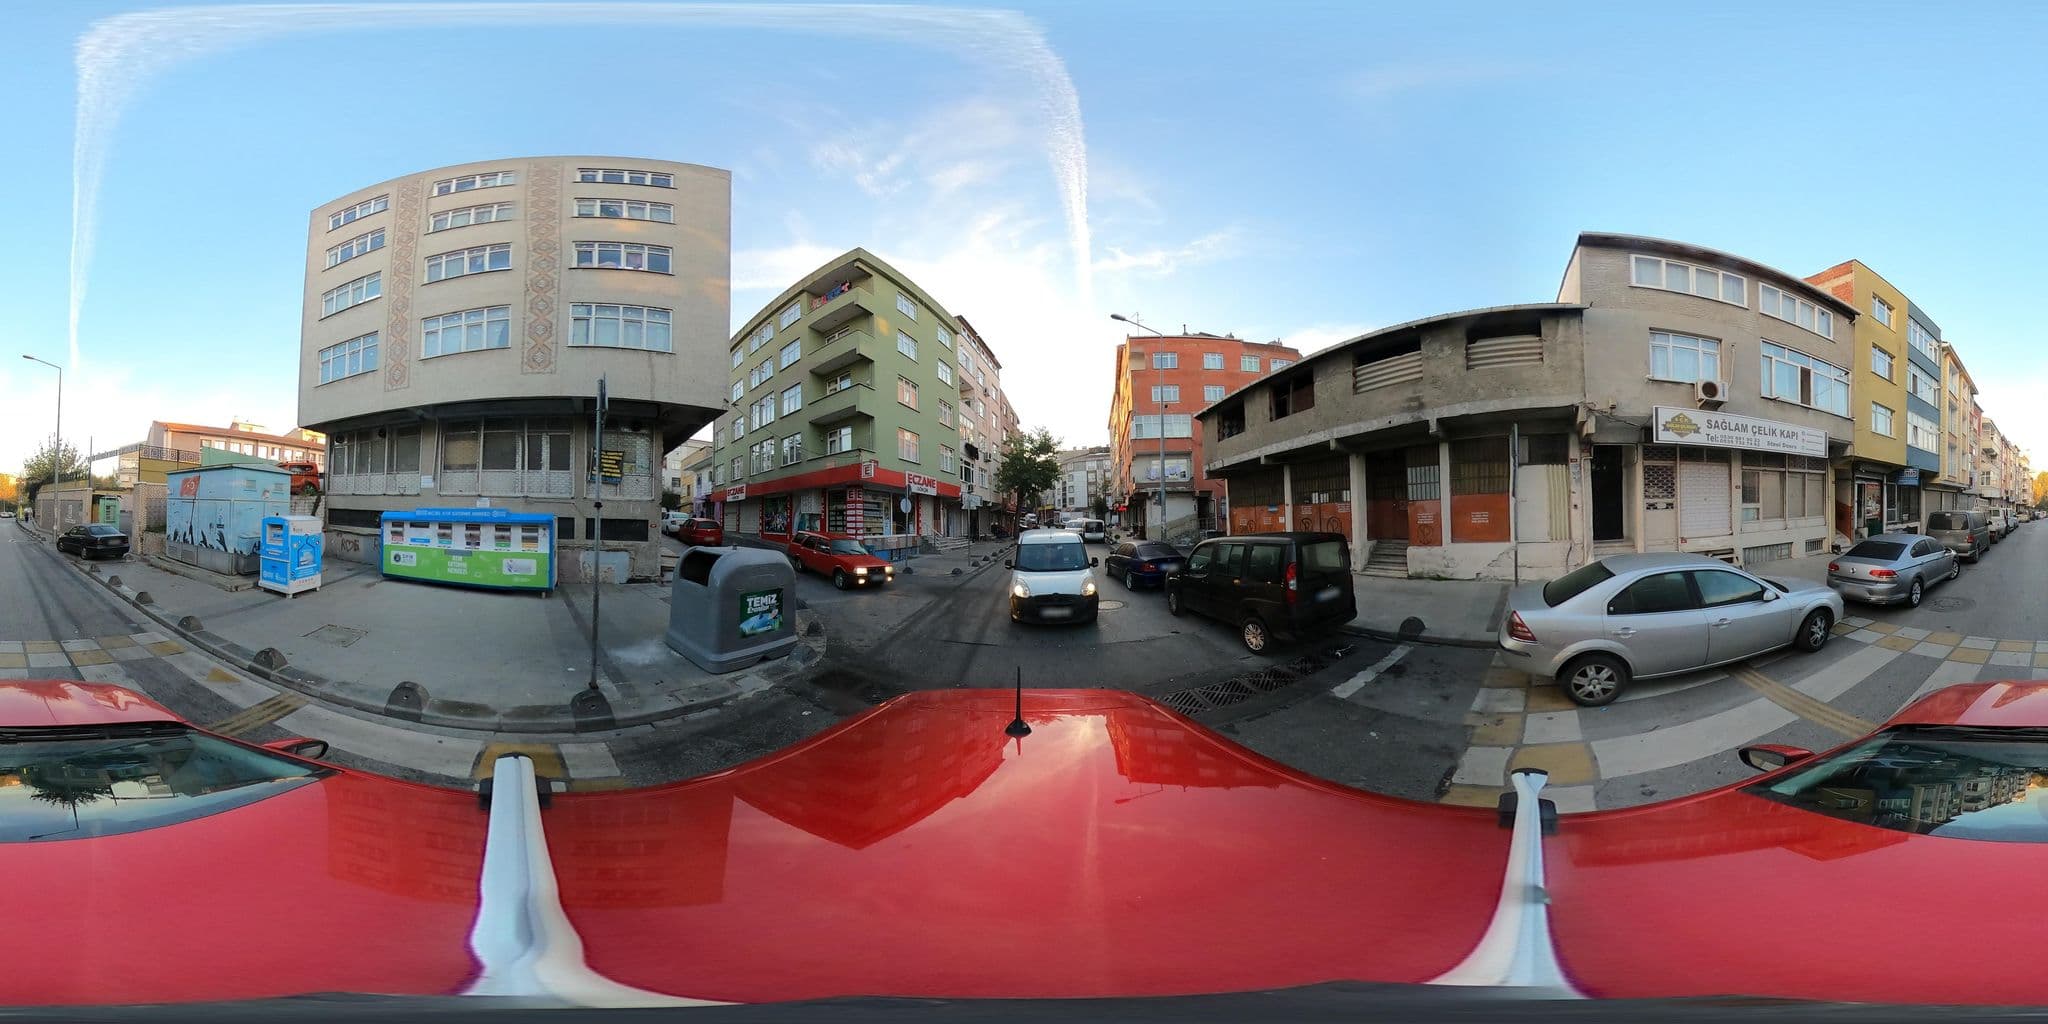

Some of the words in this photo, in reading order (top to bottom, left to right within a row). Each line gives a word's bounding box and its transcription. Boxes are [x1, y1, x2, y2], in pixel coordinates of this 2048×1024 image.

[1706, 418, 1749, 434] SAĞLAM
[1751, 425, 1777, 437] ÇELİK
[1779, 429, 1799, 441] KAPI
[907, 473, 936, 489] ECZANE
[727, 485, 745, 496] ECZANE
[746, 594, 777, 608] TEMİZ
